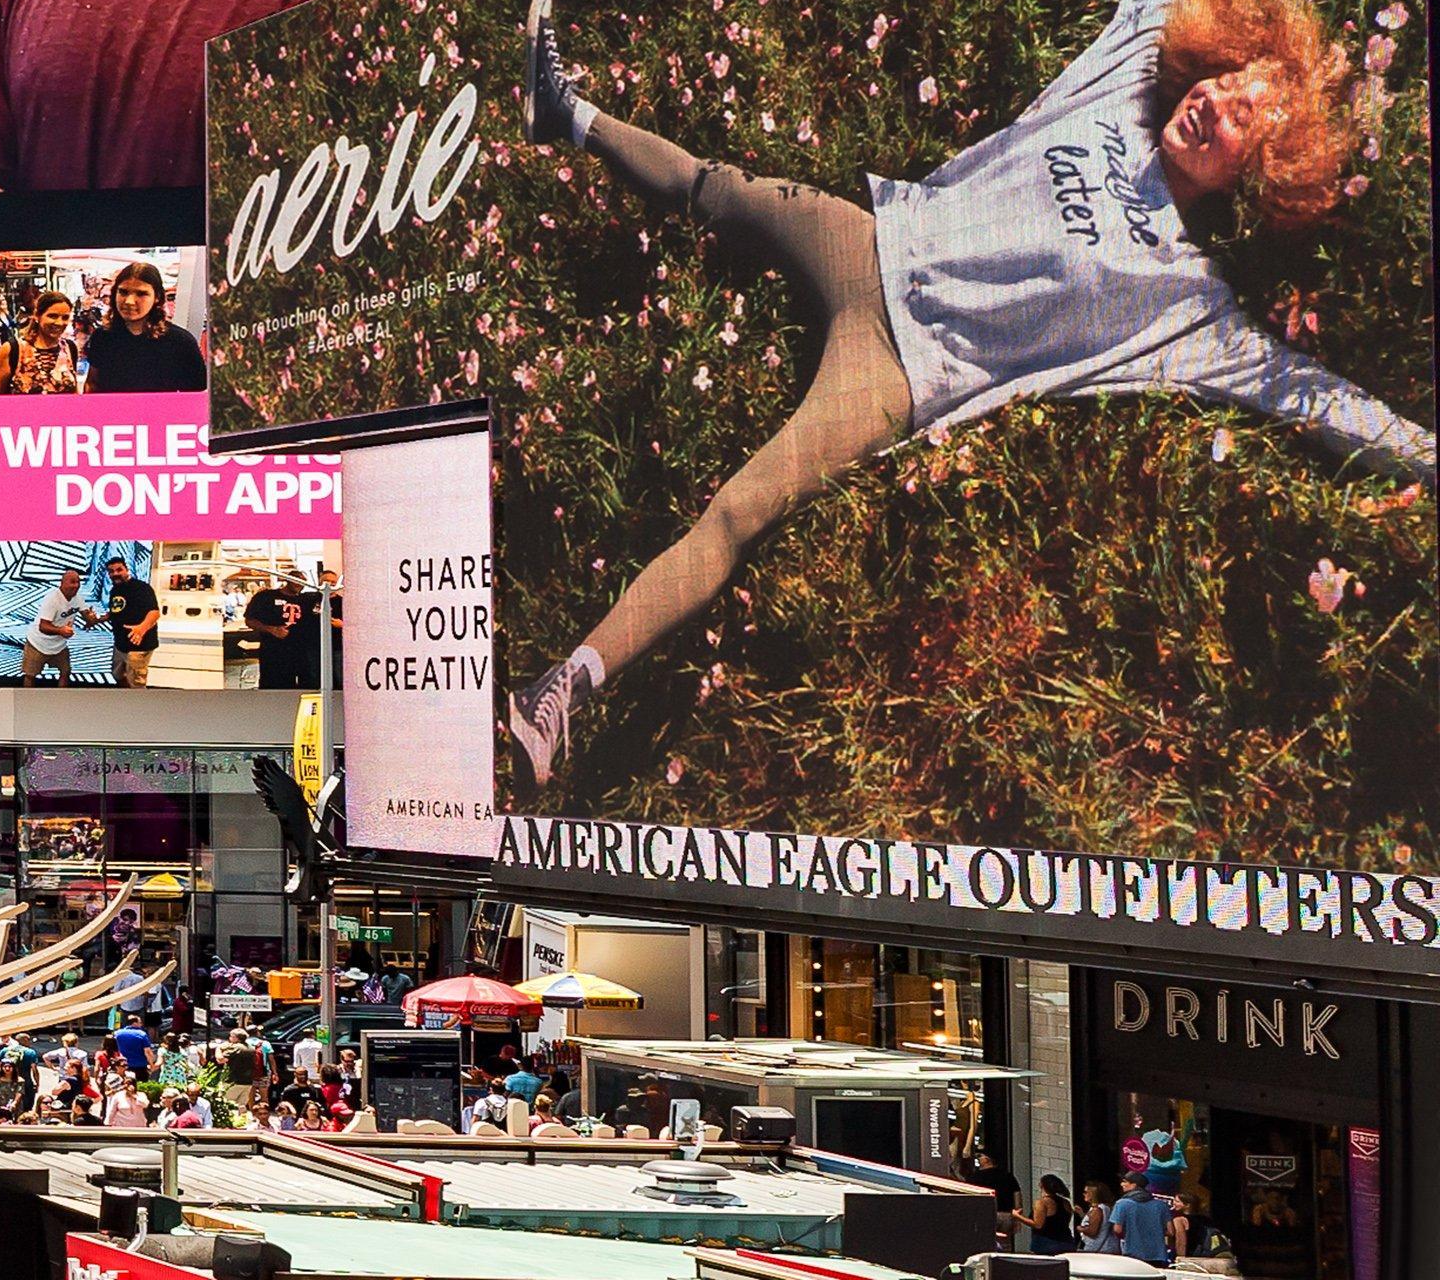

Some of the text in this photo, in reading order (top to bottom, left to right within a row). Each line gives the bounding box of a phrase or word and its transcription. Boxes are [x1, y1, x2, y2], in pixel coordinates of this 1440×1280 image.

[225, 52, 480, 287] aerie
[230, 321, 246, 341] No
[251, 303, 327, 338] retouching
[331, 296, 351, 317] on
[355, 288, 396, 314] these
[307, 323, 395, 354] #AerieREAL
[400, 555, 493, 593] SHARE
[407, 606, 488, 641] YOUR
[387, 799, 464, 818] AMERICAN
[494, 815, 1440, 948] AMERICAN EAGLE OUTFITTERS
[533, 943, 565, 968] PENSKE
[1113, 979, 1341, 1061] DRINK
[929, 1098, 942, 1158] Newsstand
[1249, 1157, 1292, 1169] DRINK
